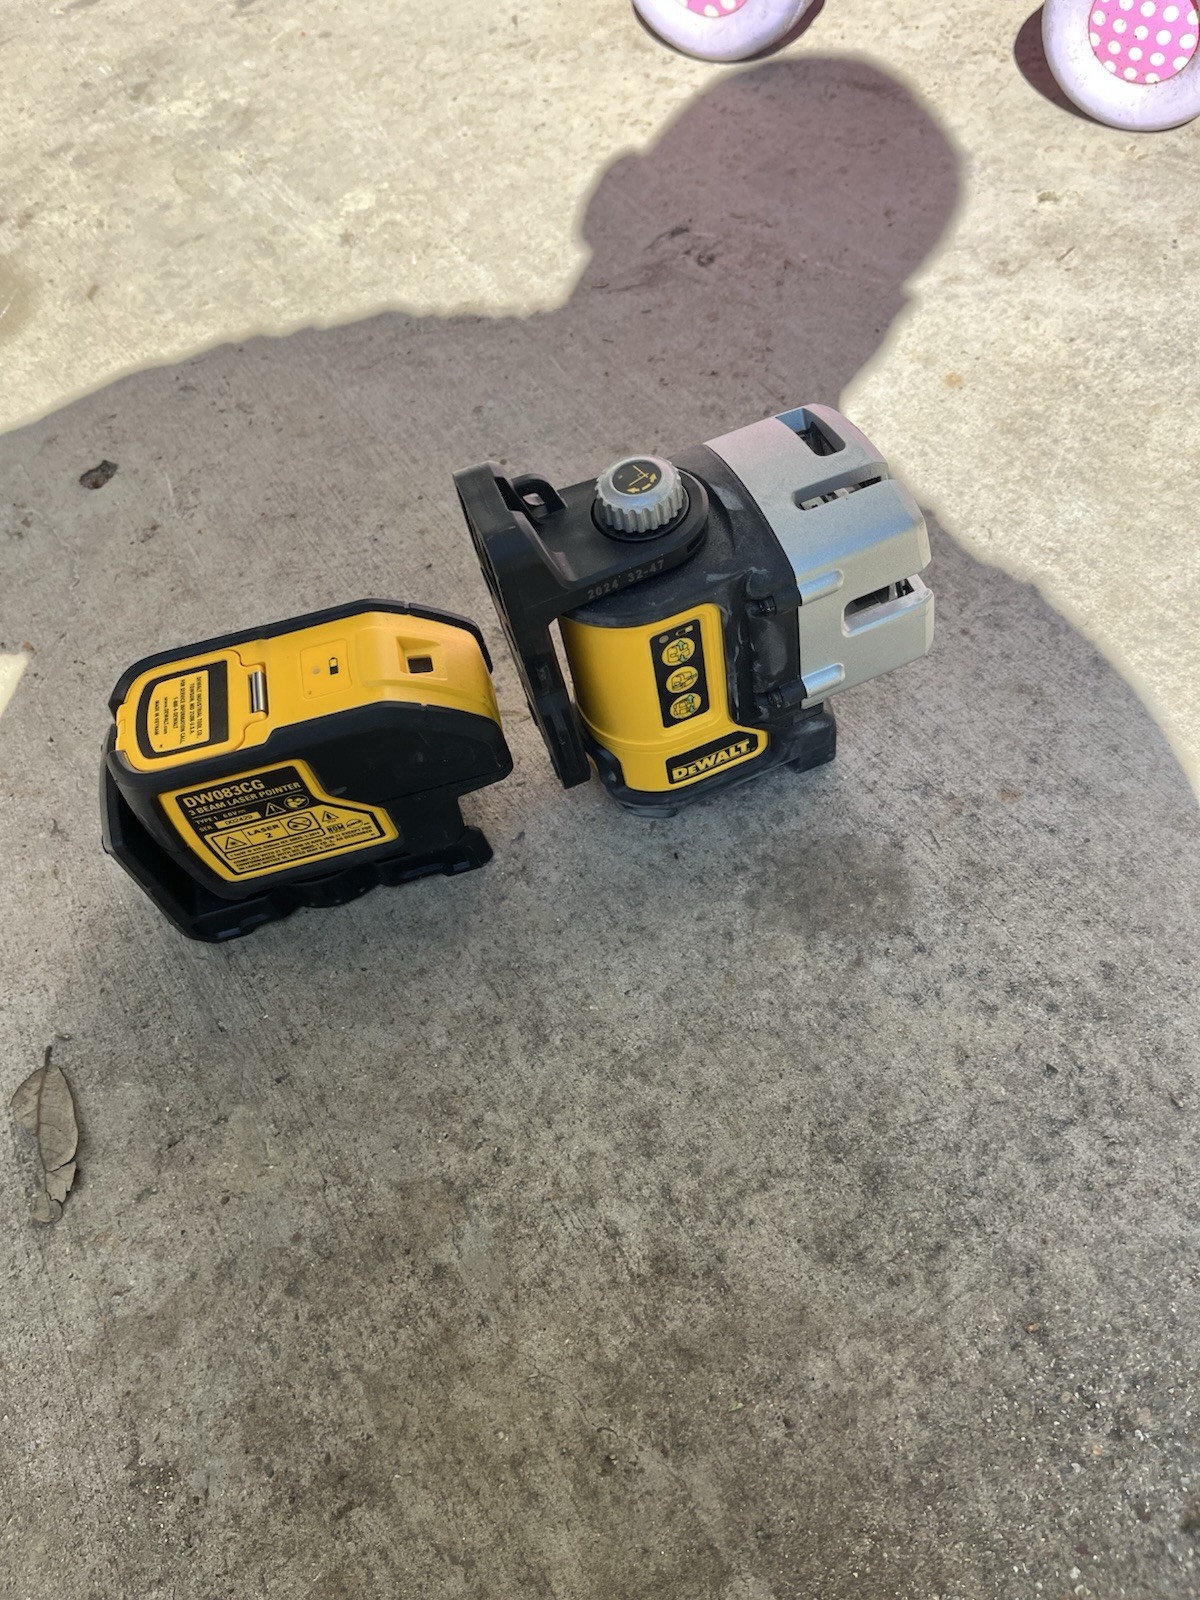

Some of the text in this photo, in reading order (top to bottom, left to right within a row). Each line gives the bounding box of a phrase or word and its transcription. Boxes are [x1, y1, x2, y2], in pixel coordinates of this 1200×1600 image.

[587, 560, 664, 600] 2024 32-47
[182, 778, 265, 808] DW083CG
[195, 801, 226, 814] BEAM
[226, 792, 258, 806] LASER
[258, 781, 301, 797] POINTER
[195, 816, 212, 825] TYPE
[247, 823, 279, 836] LASER
